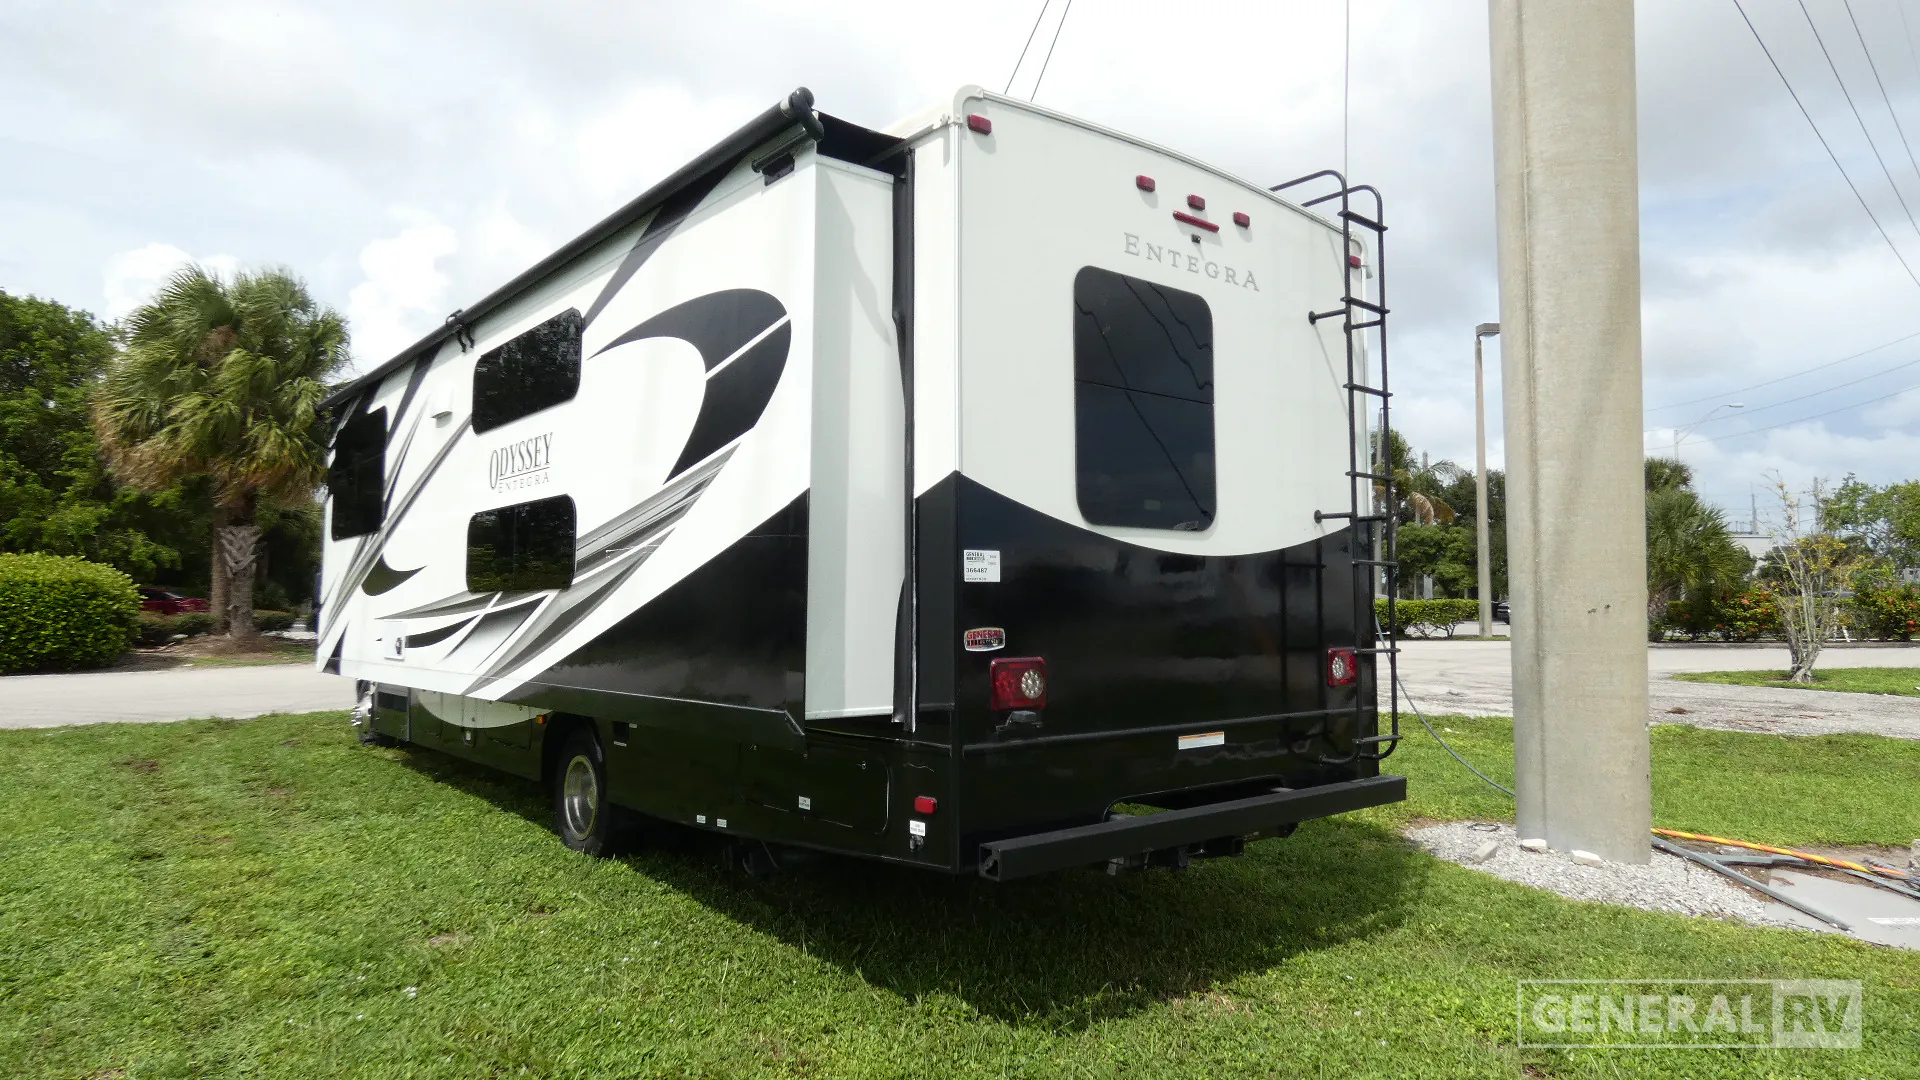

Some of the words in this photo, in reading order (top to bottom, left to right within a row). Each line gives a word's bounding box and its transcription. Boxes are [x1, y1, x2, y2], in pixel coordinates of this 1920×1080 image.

[1123, 231, 1260, 292] ENTEGRA
[489, 431, 553, 490] ODYSSEY
[498, 471, 549, 494] ENTEGRA
